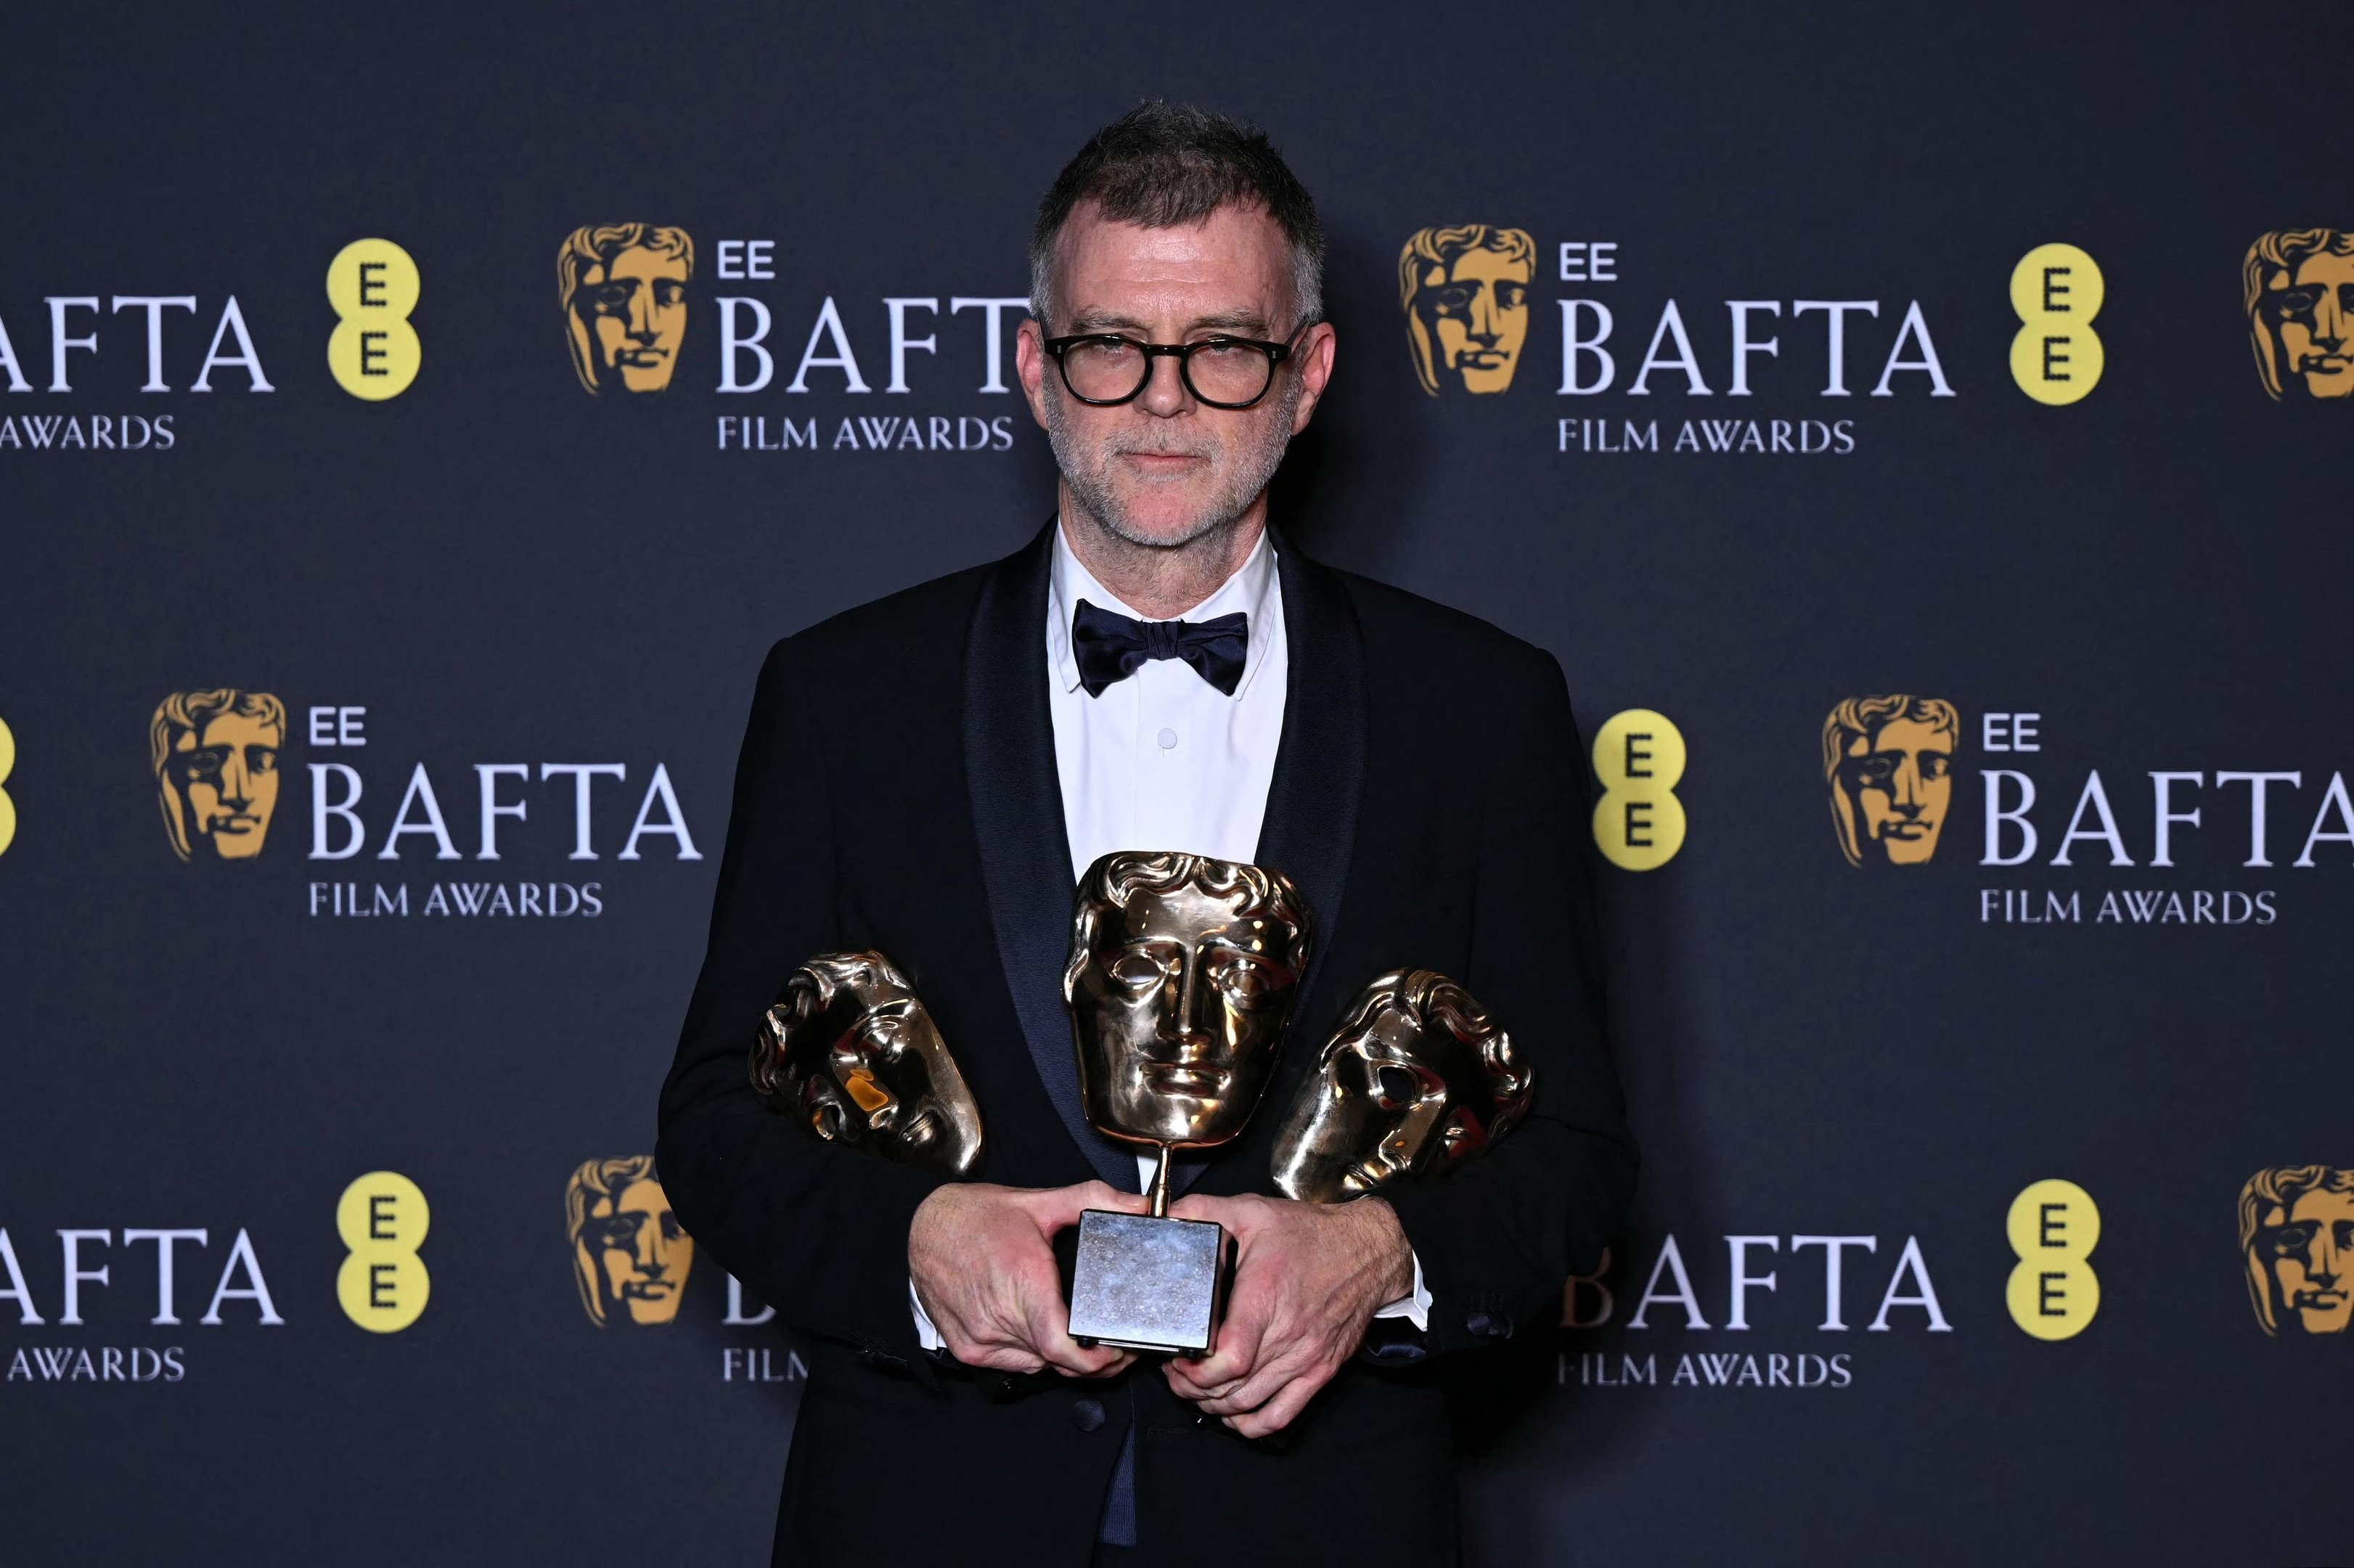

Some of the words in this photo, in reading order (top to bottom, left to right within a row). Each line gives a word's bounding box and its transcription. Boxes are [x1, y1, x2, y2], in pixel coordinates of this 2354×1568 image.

[718, 240, 777, 280] EE
[1560, 242, 1619, 282] EE
[1558, 298, 1958, 399] BAFTA
[0, 415, 176, 451] AWARDS
[718, 417, 819, 452] FILM
[833, 417, 1015, 452] AWARDS
[1558, 419, 1660, 454] FILM
[1674, 420, 1856, 455] AWARDS
[309, 706, 367, 747] EE
[1984, 714, 2042, 754] EE
[308, 762, 705, 862] BAFTA
[1979, 769, 2354, 869] BAFTA
[310, 882, 410, 918] FILM
[425, 882, 604, 918] AWARDS
[1981, 889, 2082, 924] FILM
[2096, 890, 2278, 925] AWARDS
[8, 1347, 186, 1382] AWARDS
[1558, 1352, 1657, 1387] FILM
[1672, 1353, 1853, 1388] AWARDS
